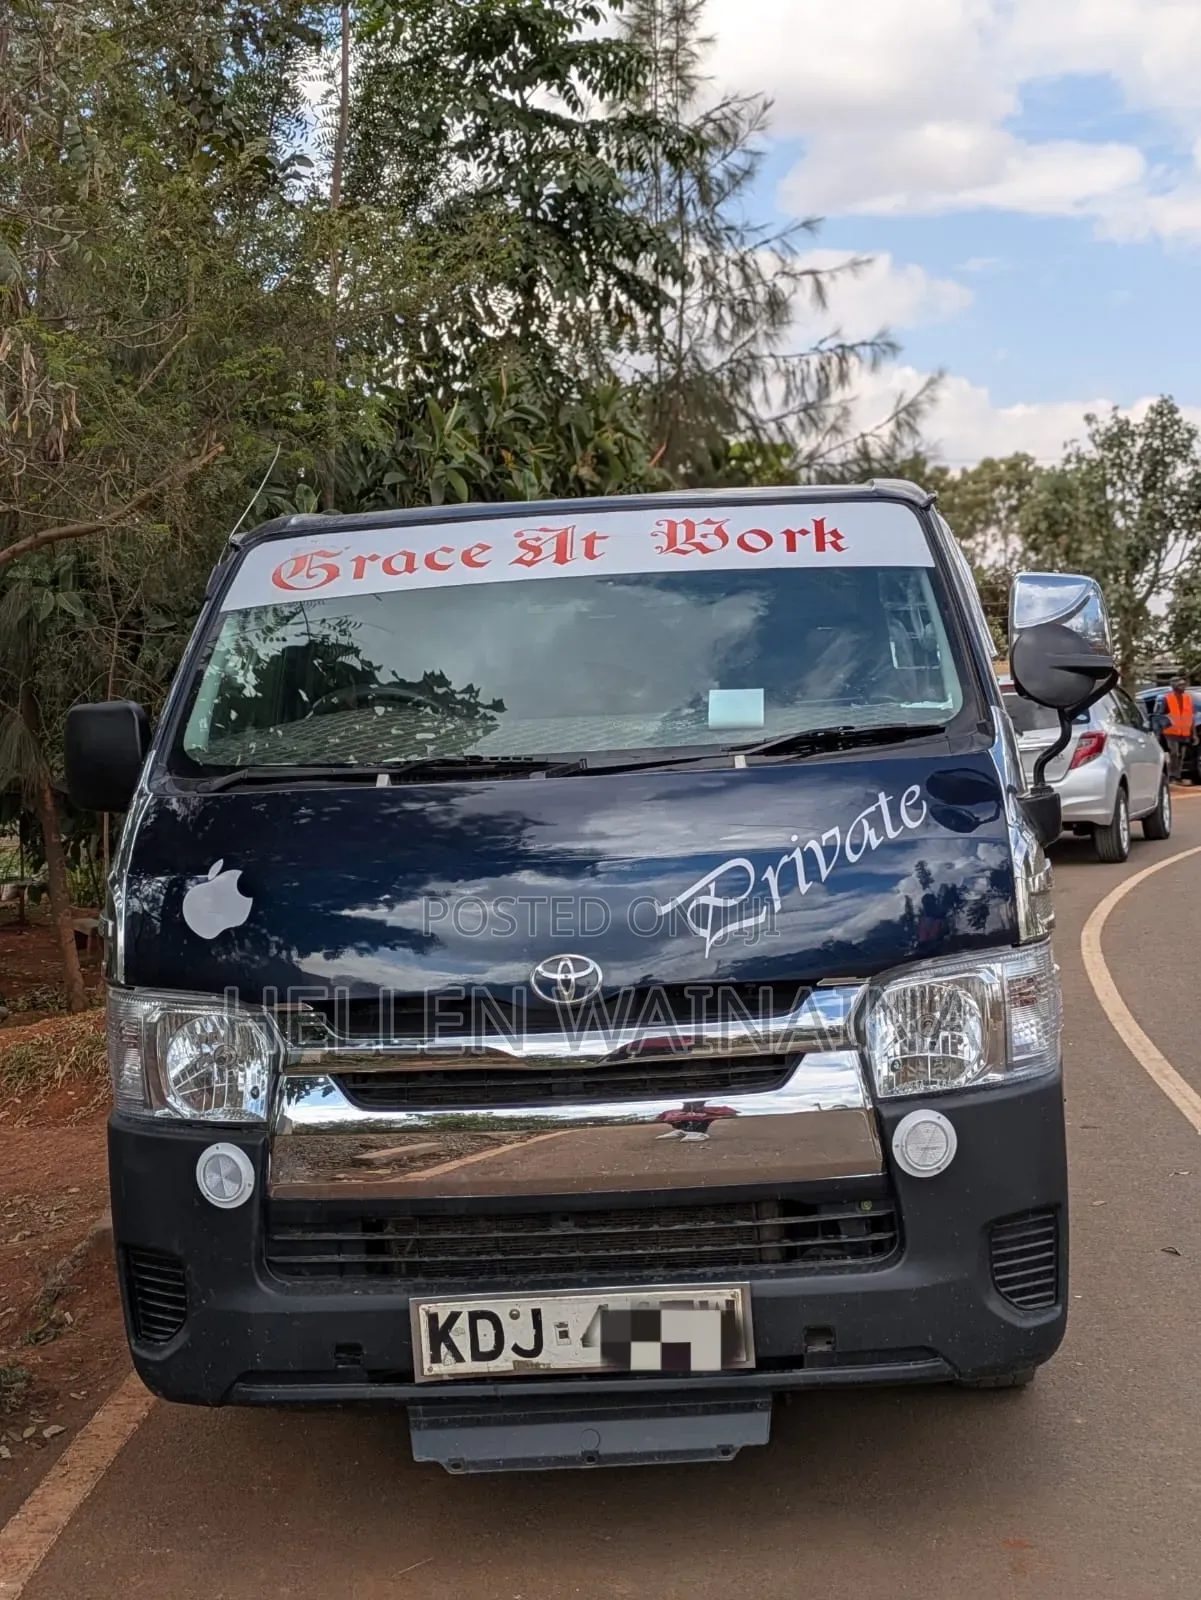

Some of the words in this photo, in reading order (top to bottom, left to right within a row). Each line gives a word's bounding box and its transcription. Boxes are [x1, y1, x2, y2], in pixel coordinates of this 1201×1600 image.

[270, 542, 493, 591] Grace
[510, 523, 611, 568] At
[651, 516, 850, 556] Work
[654, 783, 927, 959] Private
[427, 1307, 544, 1364] KDJ
